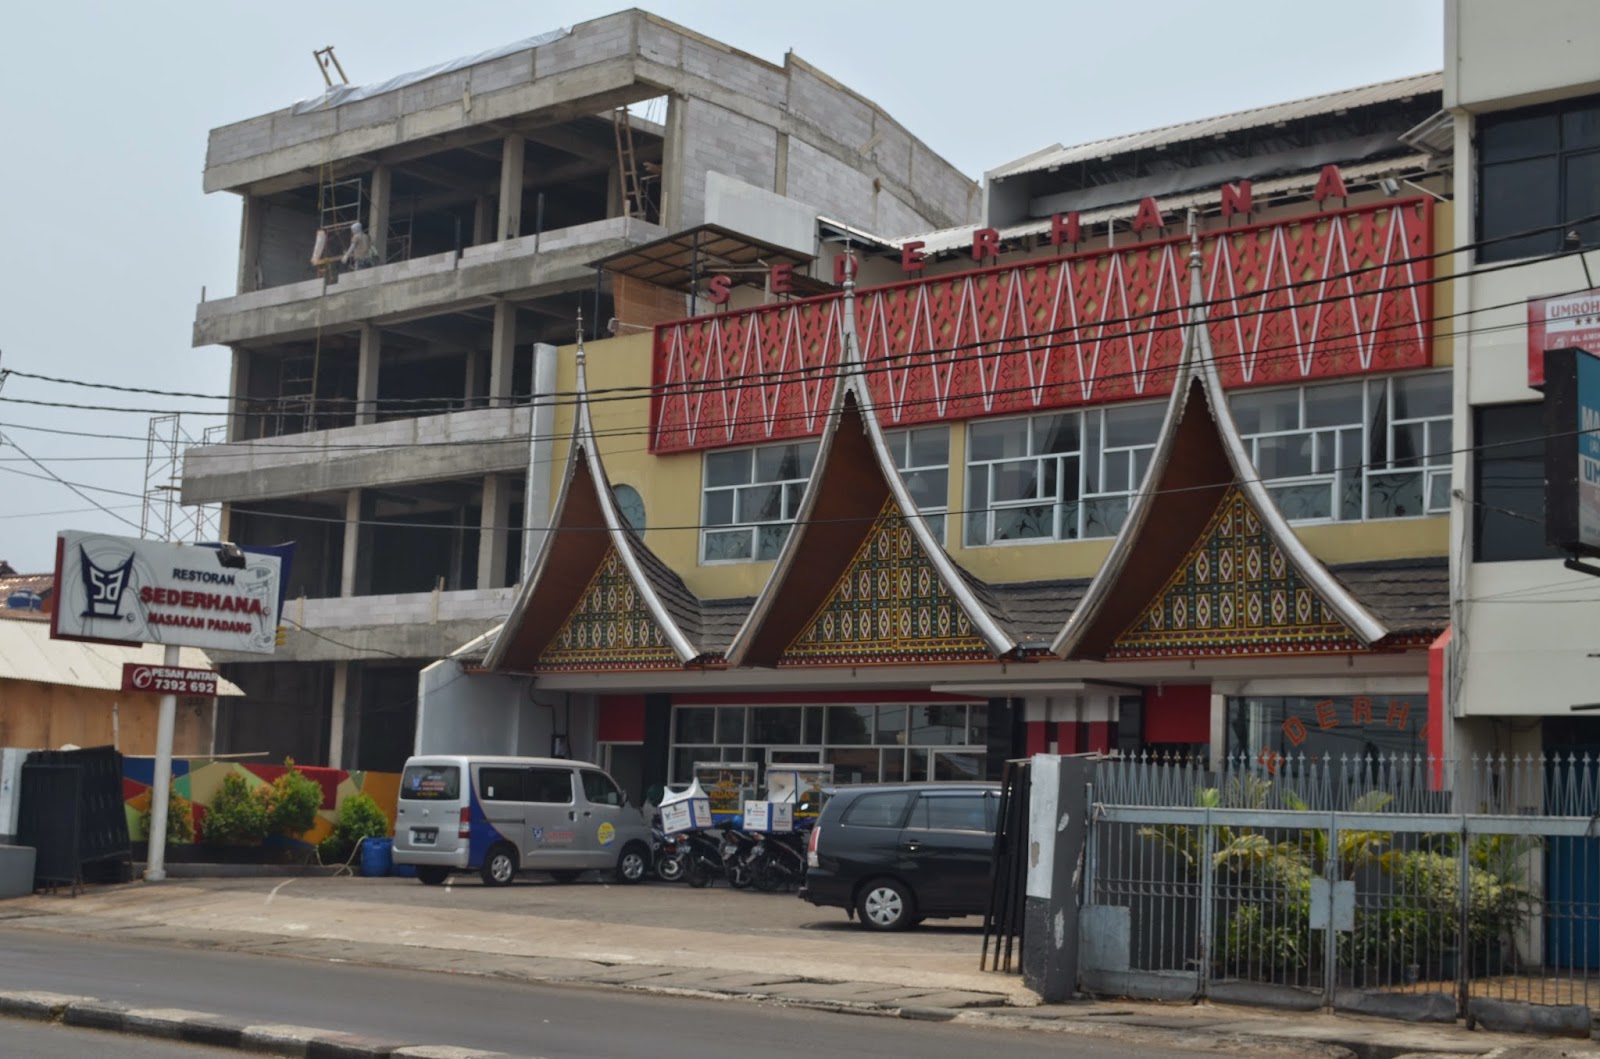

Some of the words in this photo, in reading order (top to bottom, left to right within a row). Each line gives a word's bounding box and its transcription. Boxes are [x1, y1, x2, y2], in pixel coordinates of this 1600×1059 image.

[708, 163, 1348, 305] SEDERHANA
[1551, 300, 1600, 318] UMROH
[172, 567, 235, 586] RESTORAN
[140, 585, 263, 616] SEDERHANA
[147, 612, 205, 629] MASAKAN
[207, 618, 252, 635] PADANG
[151, 668, 185, 680] PESAN
[186, 669, 218, 682] ANTAR
[154, 679, 187, 692] 7392
[190, 681, 215, 694] 692
